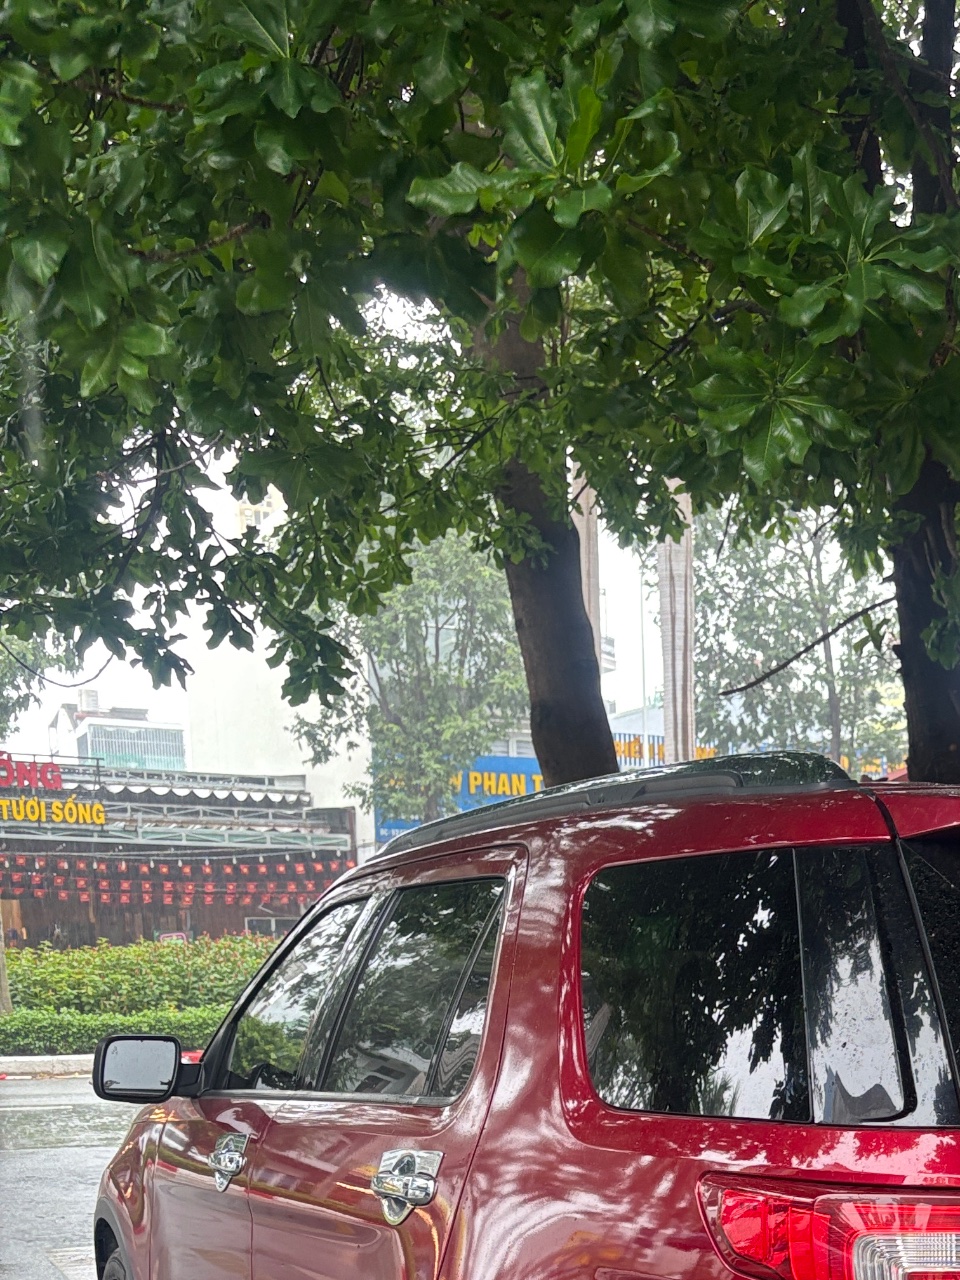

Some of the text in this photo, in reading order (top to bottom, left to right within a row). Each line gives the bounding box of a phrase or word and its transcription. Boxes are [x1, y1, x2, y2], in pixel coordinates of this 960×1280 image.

[469, 771, 526, 796] PHAN
[0, 793, 105, 825] TƯƠI SỐNG
